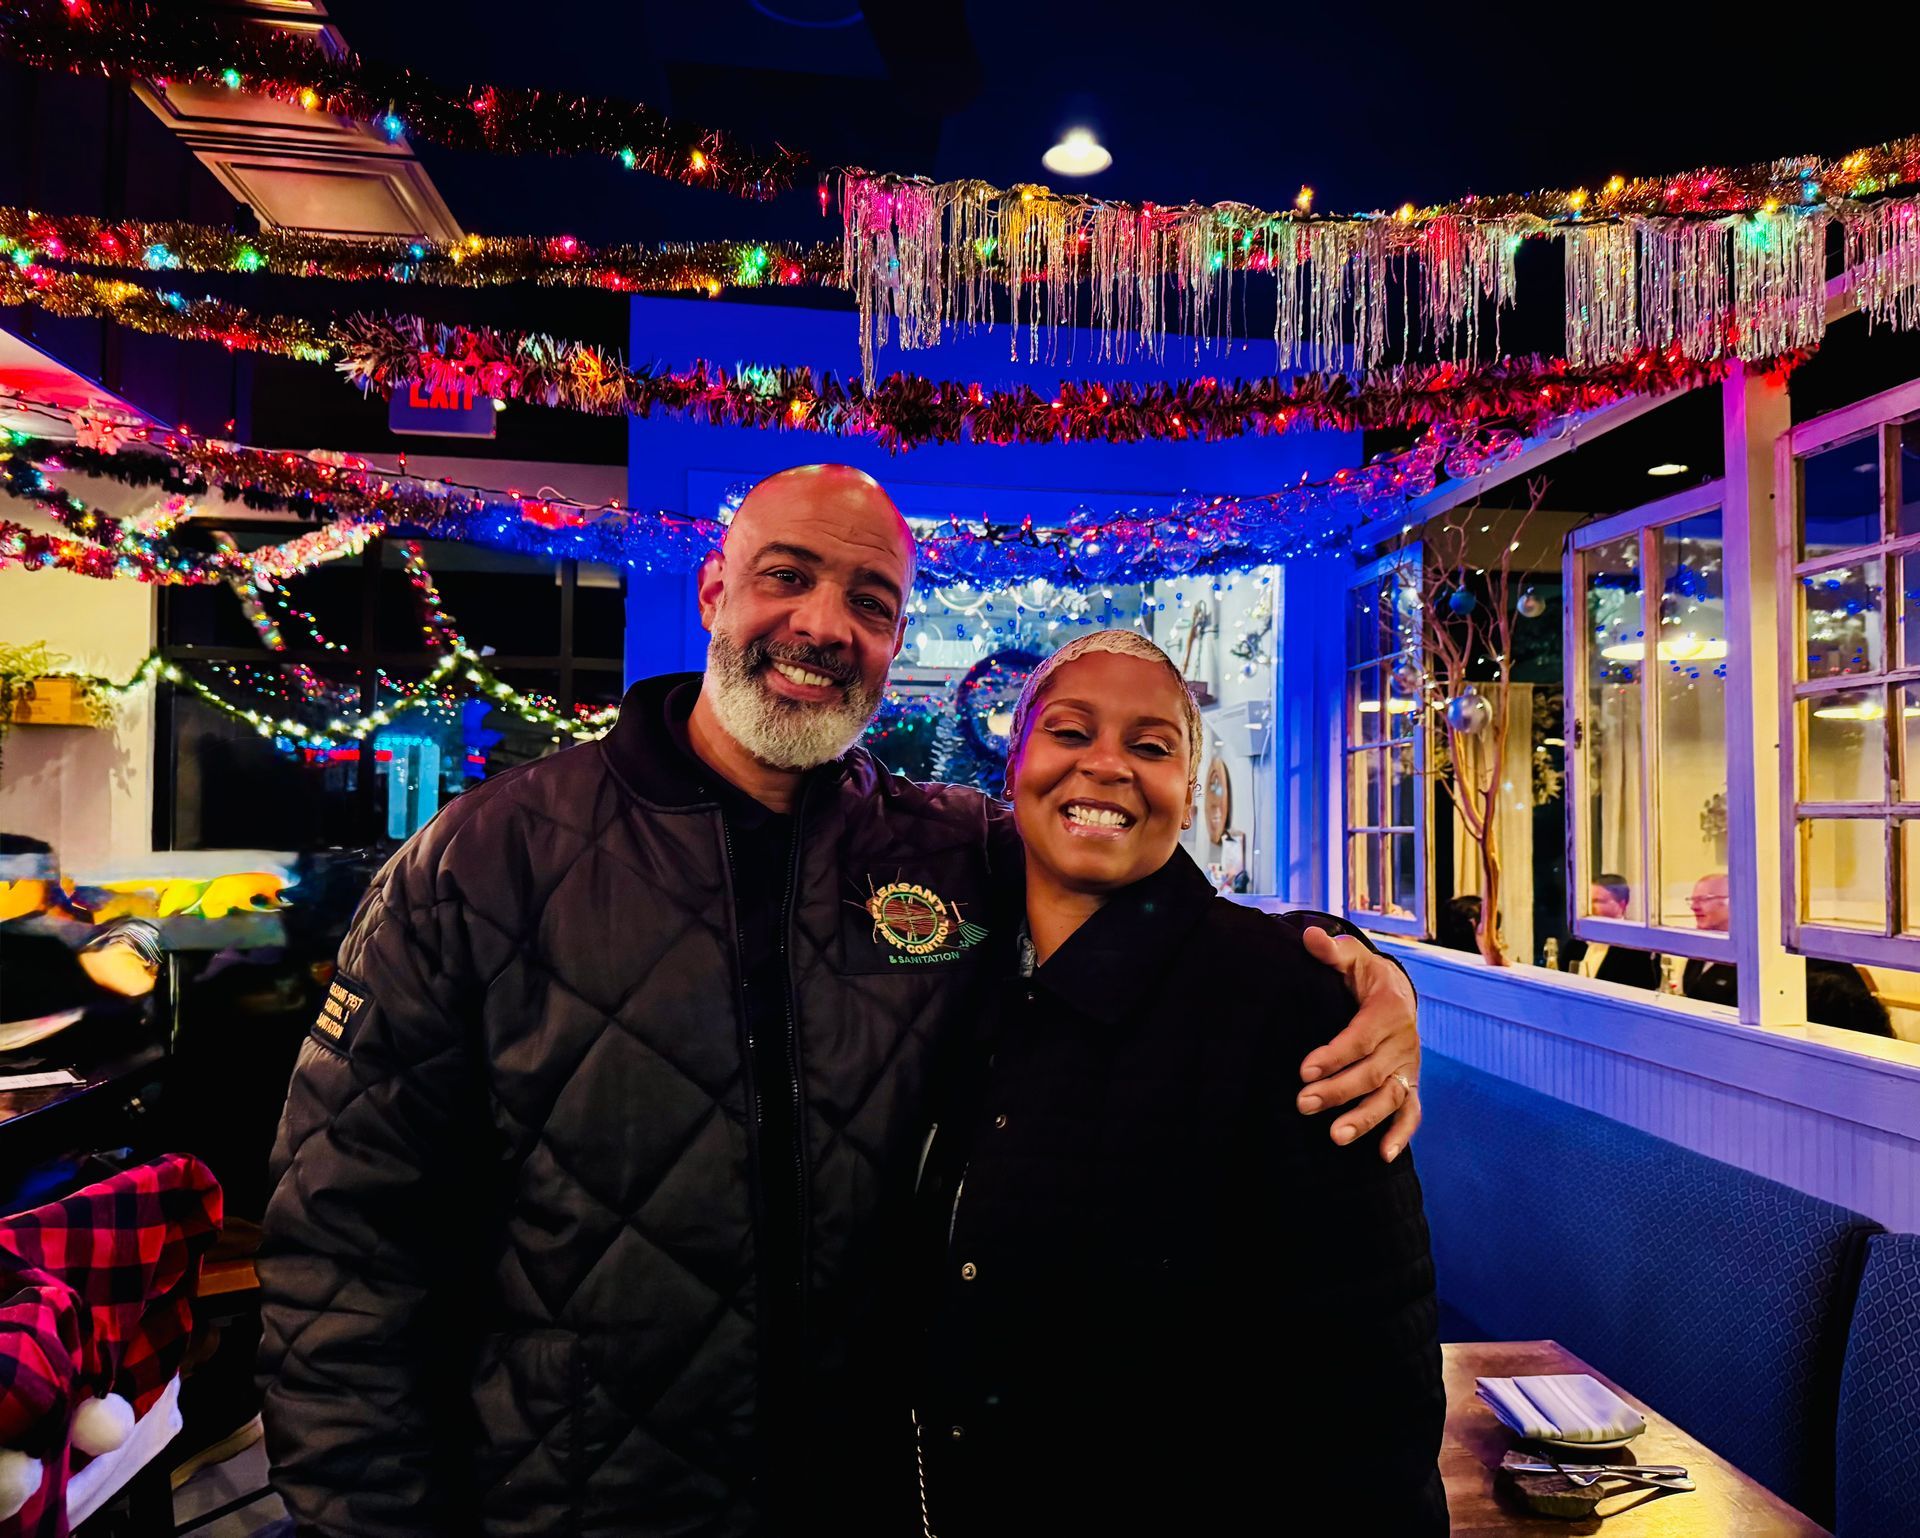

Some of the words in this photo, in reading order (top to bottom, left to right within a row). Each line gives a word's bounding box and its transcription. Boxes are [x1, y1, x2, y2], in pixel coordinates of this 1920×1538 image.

[871, 882, 947, 920] PLEASANT
[877, 922, 906, 950] PEST
[905, 920, 949, 955] CONTROL
[888, 955, 898, 964] &
[897, 951, 960, 964] SANITATION
